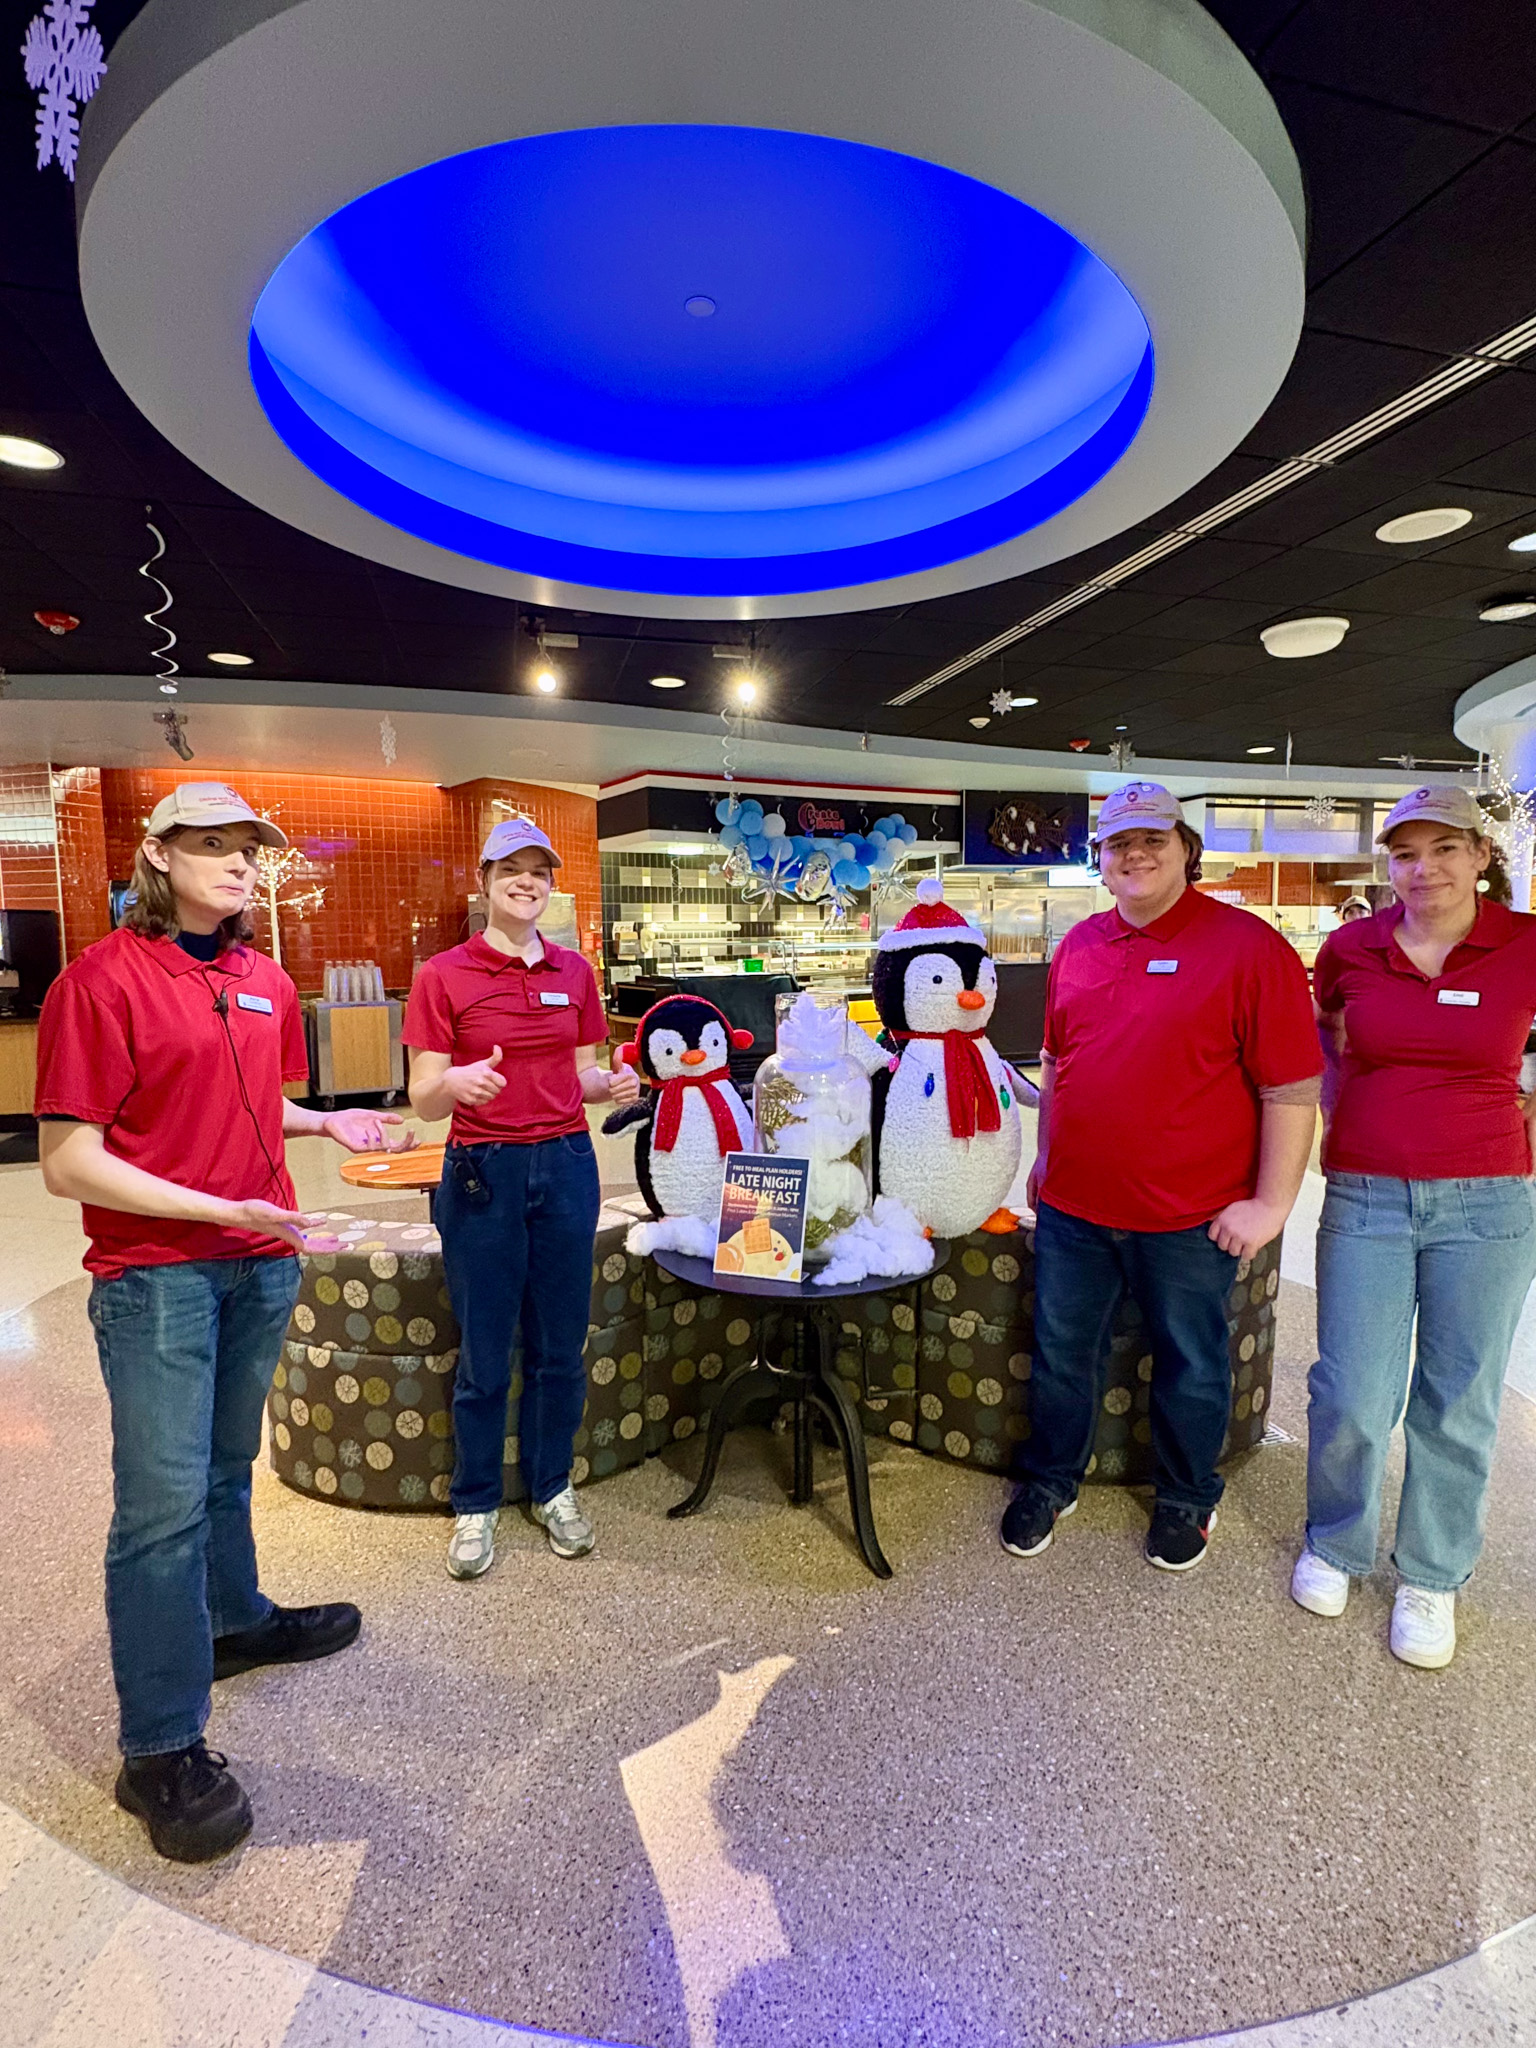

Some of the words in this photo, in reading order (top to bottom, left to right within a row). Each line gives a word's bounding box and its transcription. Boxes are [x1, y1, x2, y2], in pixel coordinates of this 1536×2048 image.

[731, 1173, 760, 1187] LATE
[762, 1175, 802, 1190] NIGHT
[729, 1187, 801, 1205] BREAKFAST
